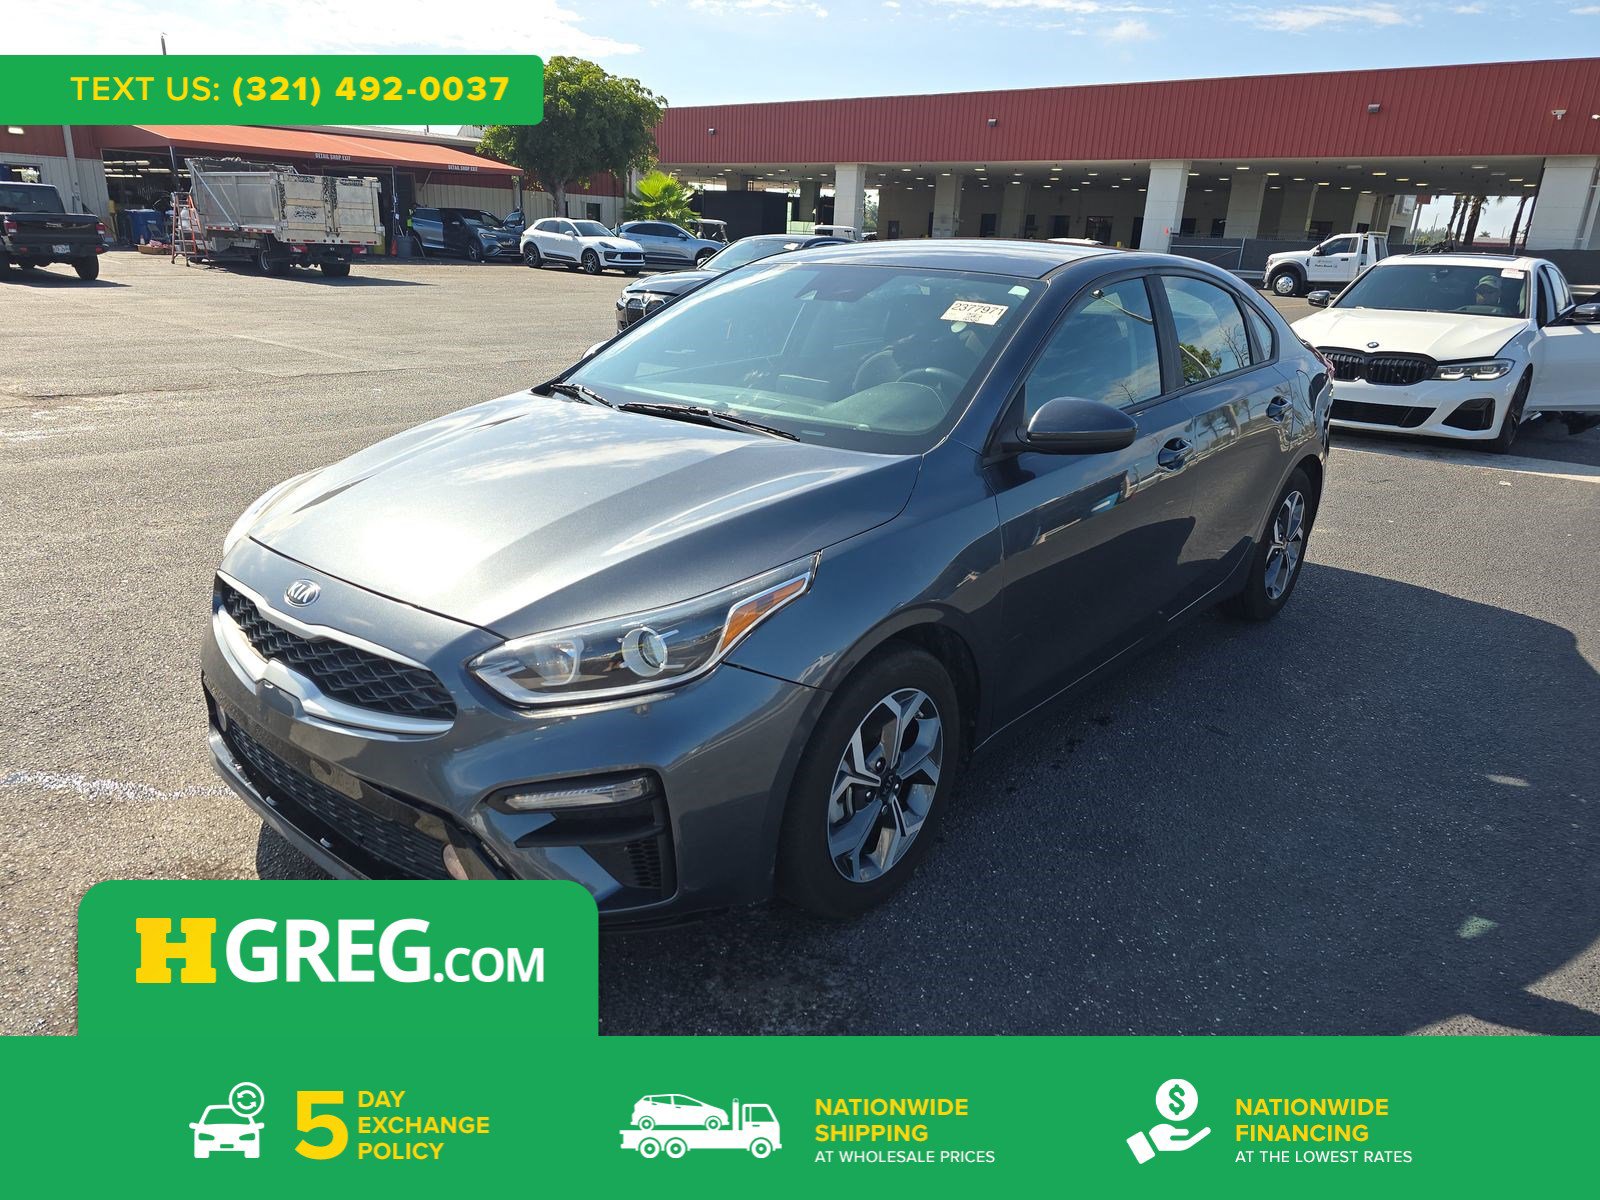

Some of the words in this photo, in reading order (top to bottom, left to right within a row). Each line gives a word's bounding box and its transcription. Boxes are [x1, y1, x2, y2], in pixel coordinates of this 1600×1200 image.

[315, 152, 329, 160] DETAIL
[951, 303, 1004, 315] 2377971
[287, 581, 312, 603] KIA
